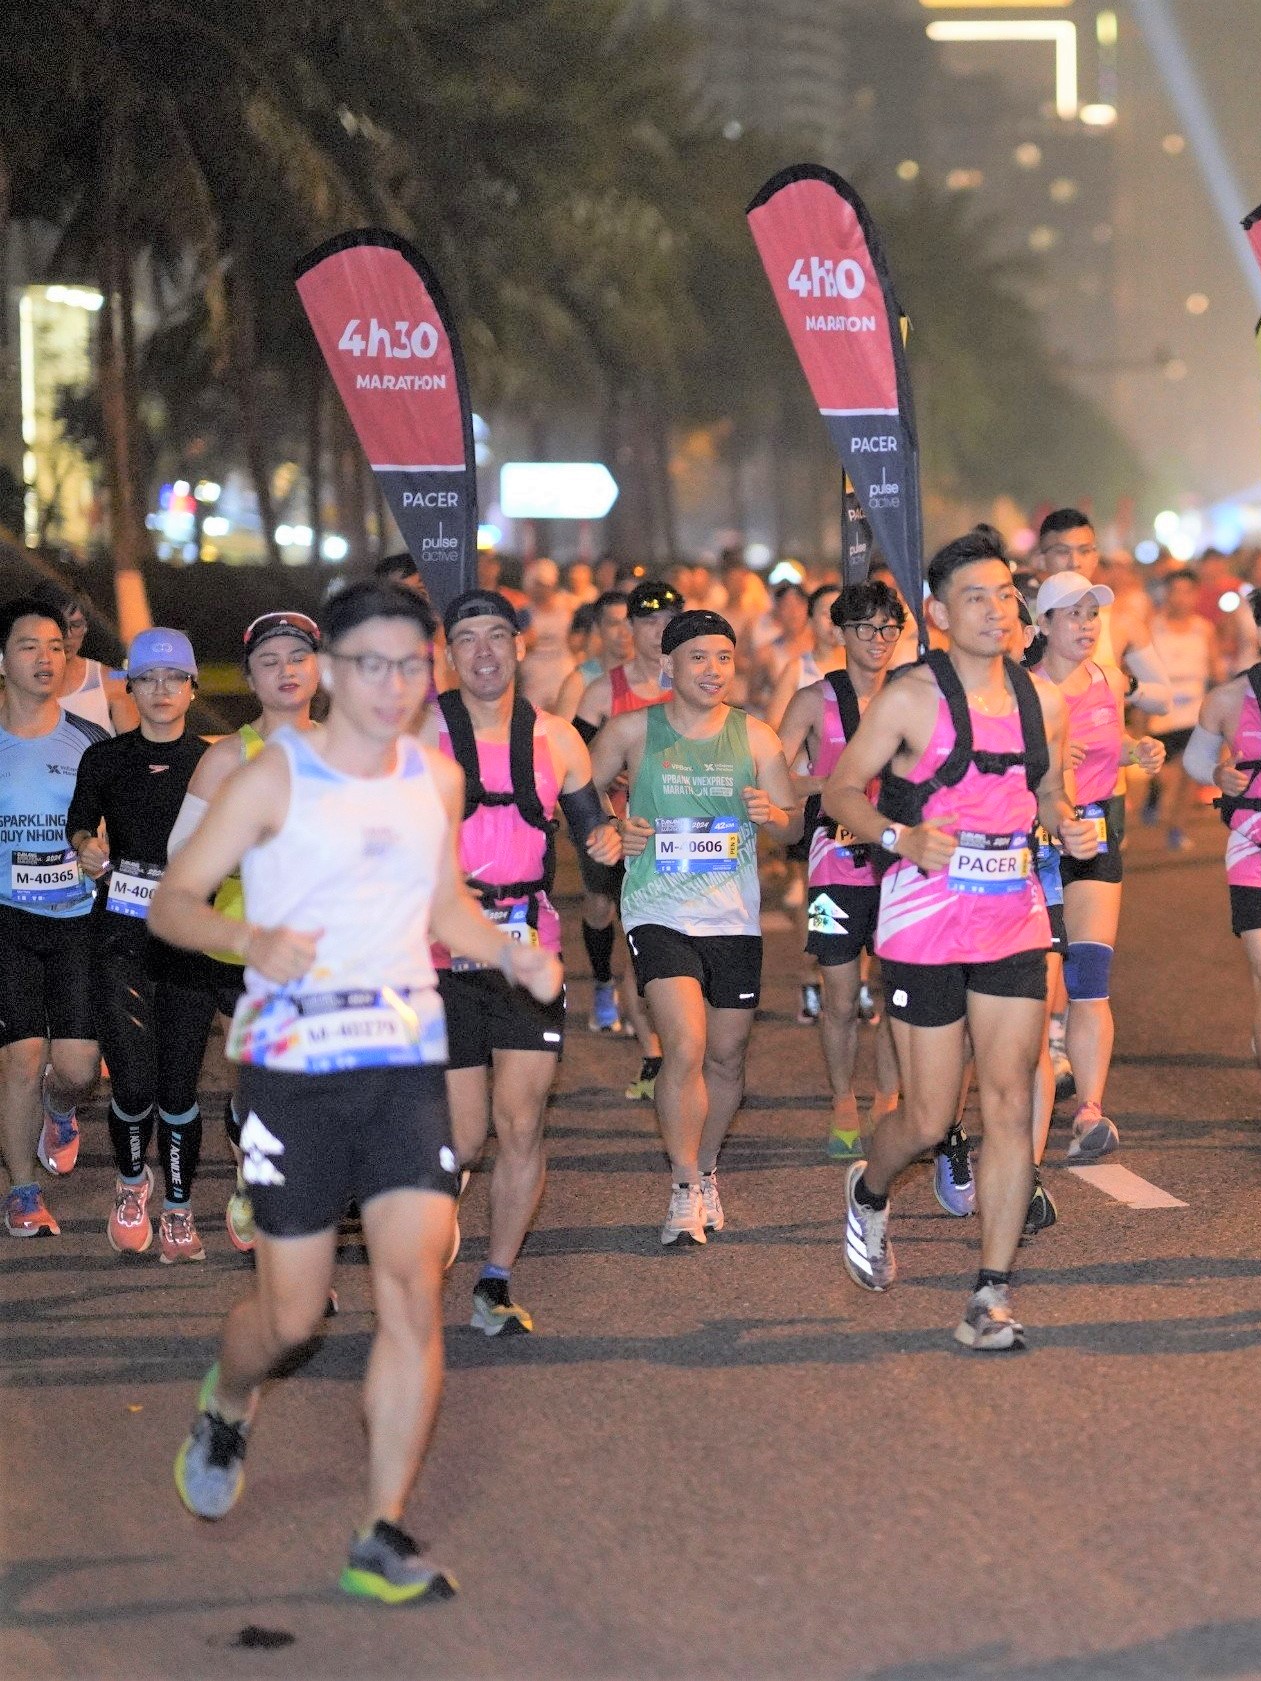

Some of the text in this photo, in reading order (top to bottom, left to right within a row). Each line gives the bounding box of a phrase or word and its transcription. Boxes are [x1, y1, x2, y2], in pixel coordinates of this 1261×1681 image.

[338, 318, 438, 358] 4h30
[356, 374, 446, 390] MARATHON
[851, 436, 897, 452] PACER
[870, 467, 898, 497] pulse
[403, 493, 458, 507] PACER
[422, 522, 458, 549] pulse
[850, 531, 866, 557] pulse
[422, 550, 458, 562] active
[662, 774, 733, 787] VPBANK VNEXPRESS
[0, 815, 66, 828] SPARKLING
[692, 821, 709, 829] 2024
[715, 822, 735, 830] 42KM
[1, 829, 64, 843] QUY NHON
[661, 841, 722, 853] M-0606
[958, 856, 1017, 873] PACER
[17, 869, 73, 883] M-40365
[170, 1144, 181, 1185] AONIJIE
